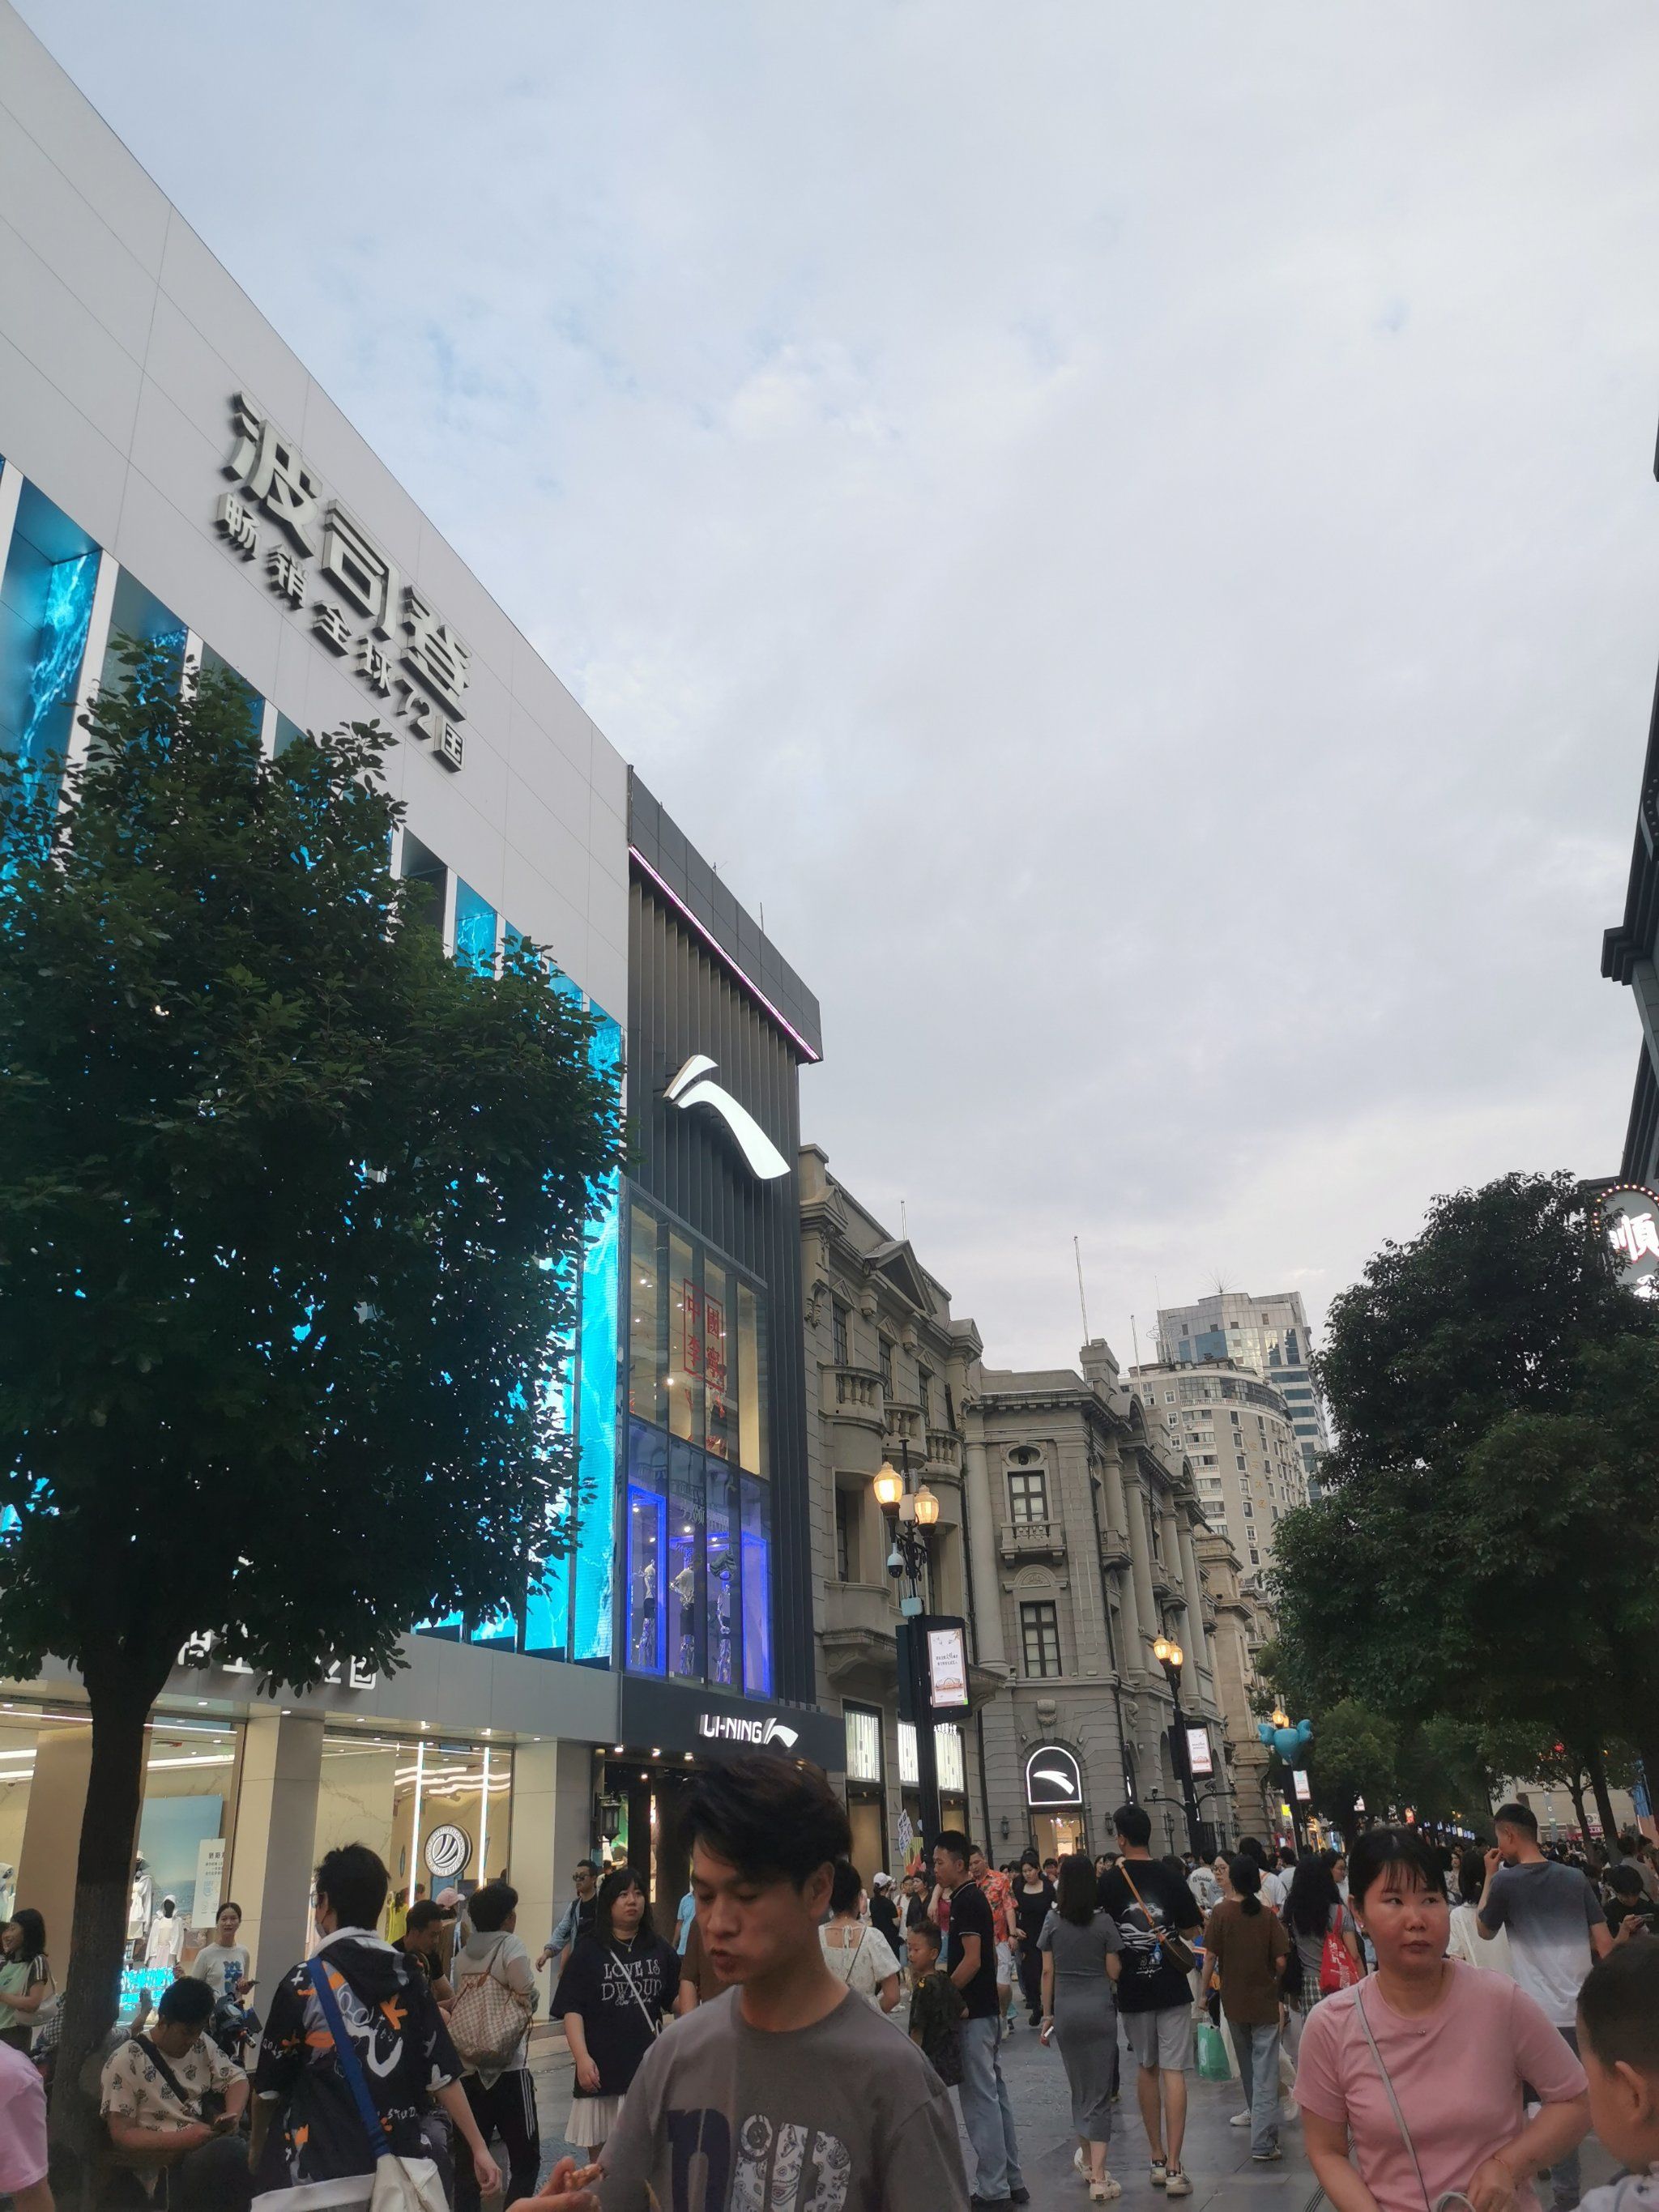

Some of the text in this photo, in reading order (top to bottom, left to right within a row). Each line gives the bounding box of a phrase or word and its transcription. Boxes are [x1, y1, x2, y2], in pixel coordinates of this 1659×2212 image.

[215, 492, 465, 773] 畅销全球72国
[223, 391, 472, 721] 波司登
[700, 1714, 763, 1744] LI-NING
[603, 1958, 660, 1980] LOVE IS
